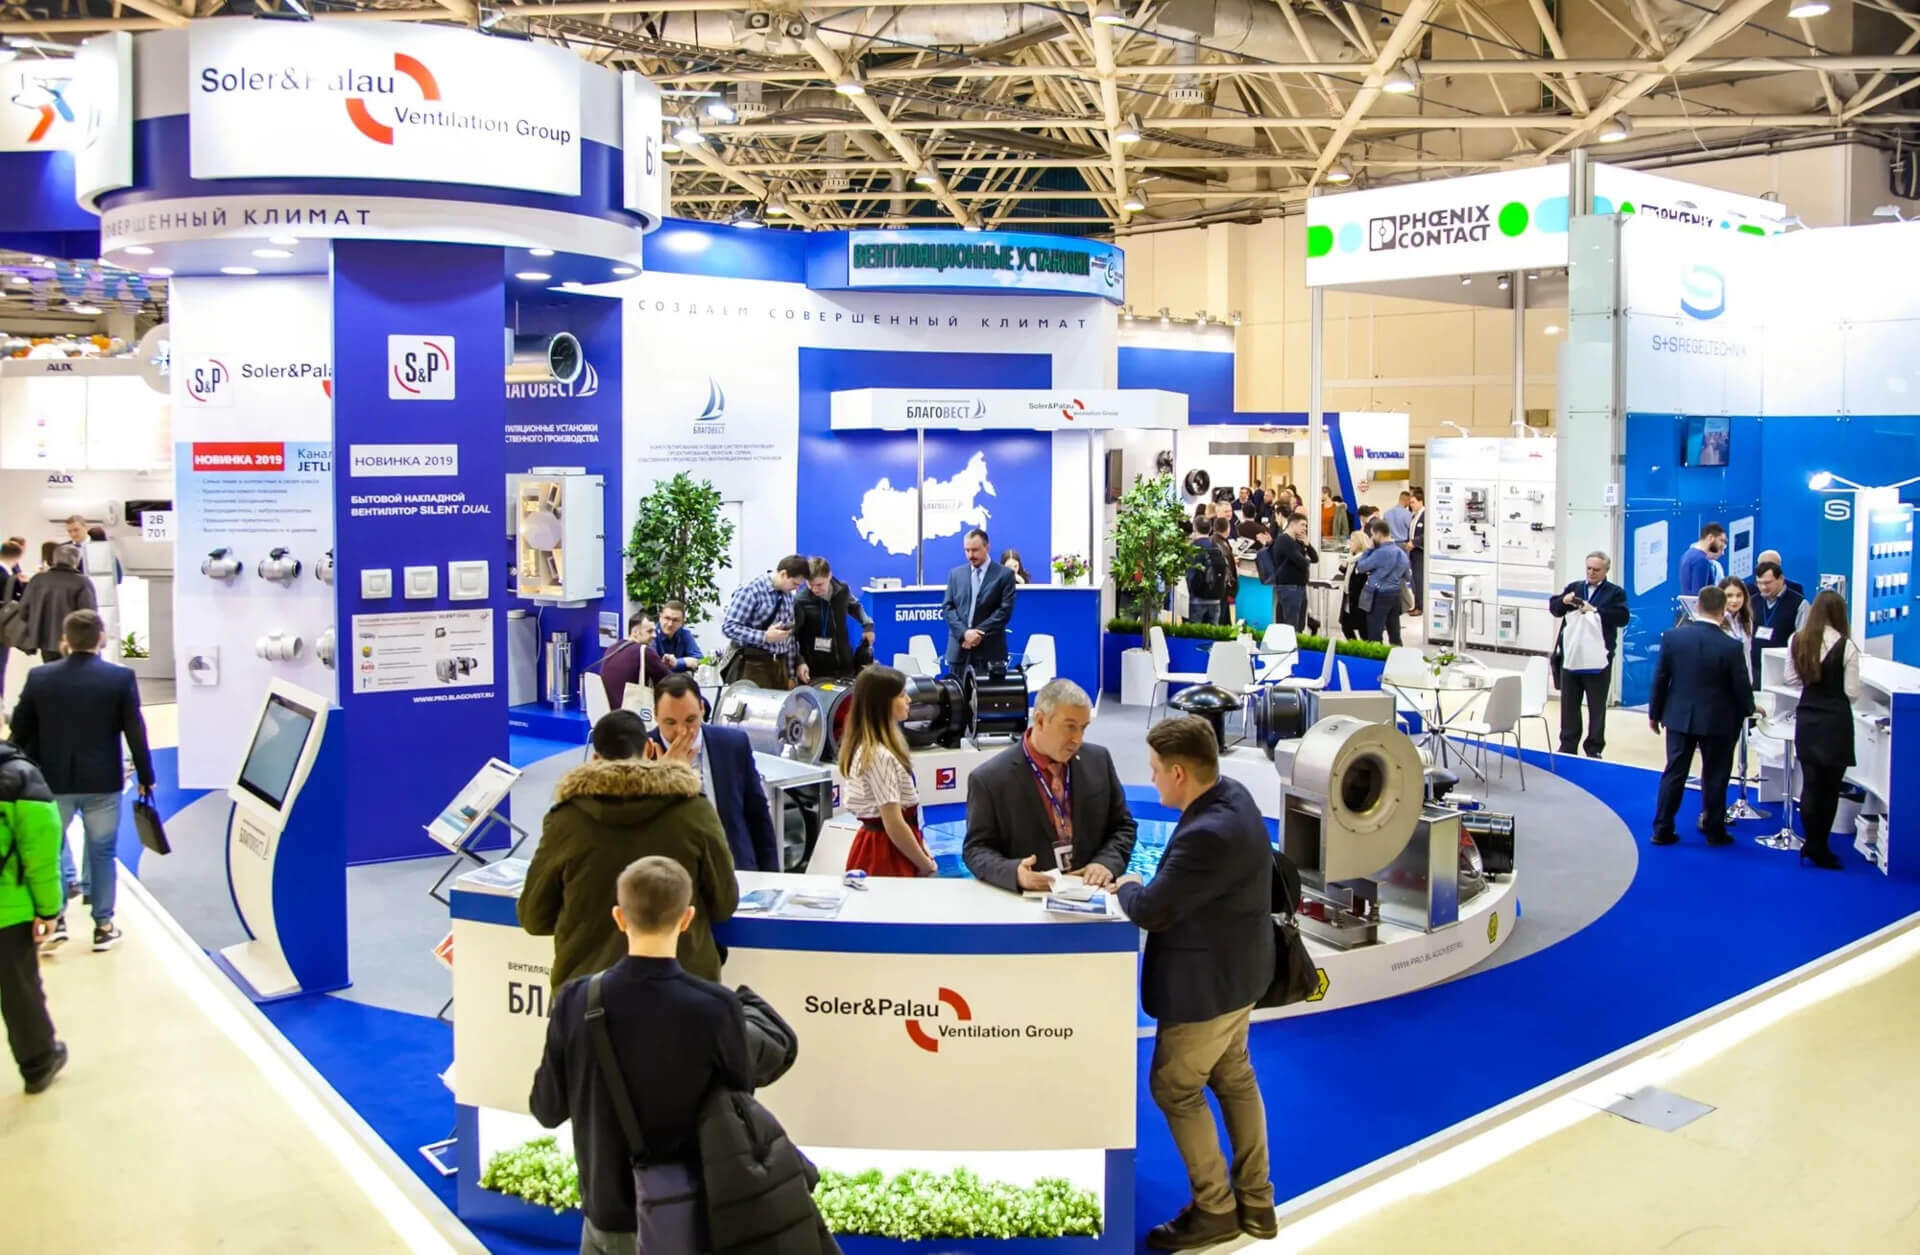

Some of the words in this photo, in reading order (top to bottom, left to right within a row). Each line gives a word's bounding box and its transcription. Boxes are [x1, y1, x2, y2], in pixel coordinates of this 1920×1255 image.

[395, 106, 508, 133] Ventilation
[516, 119, 571, 145] Group
[244, 208, 371, 225] КЛИМАТ
[1399, 204, 1490, 230] PHŒNIX
[1398, 223, 1491, 248] CONTACT
[853, 243, 1014, 272] ВЕНТИЛЯЦИОННЫЕ
[1015, 246, 1090, 276] УСТАНОВКИ
[638, 300, 748, 317] СОЗДАЕМ
[769, 308, 958, 327] СОВЕРШЕННЫЙ
[981, 318, 1086, 329] КЛИМАТ
[46, 363, 73, 372] AUX
[405, 352, 438, 383] S&P
[195, 368, 220, 393] S&P
[907, 406, 970, 419] БЛАГОВЕСТ
[195, 454, 253, 465] НОВИНКА
[255, 454, 283, 465] 2019
[355, 456, 420, 466] НОВИНКА
[424, 456, 453, 466] 2019
[48, 475, 73, 483] AUX
[351, 494, 401, 504] БЫТОВОЙ
[404, 492, 465, 504] НАКЛАДНОЙ
[351, 506, 418, 517] ВЕНТИЛЯТОР
[420, 505, 459, 515] SILENT
[462, 504, 491, 514] DUAL
[147, 528, 166, 538] 701
[805, 995, 939, 1018] Soler&Palau
[938, 1024, 1021, 1039] Ventilation
[1025, 1025, 1074, 1040] Group
